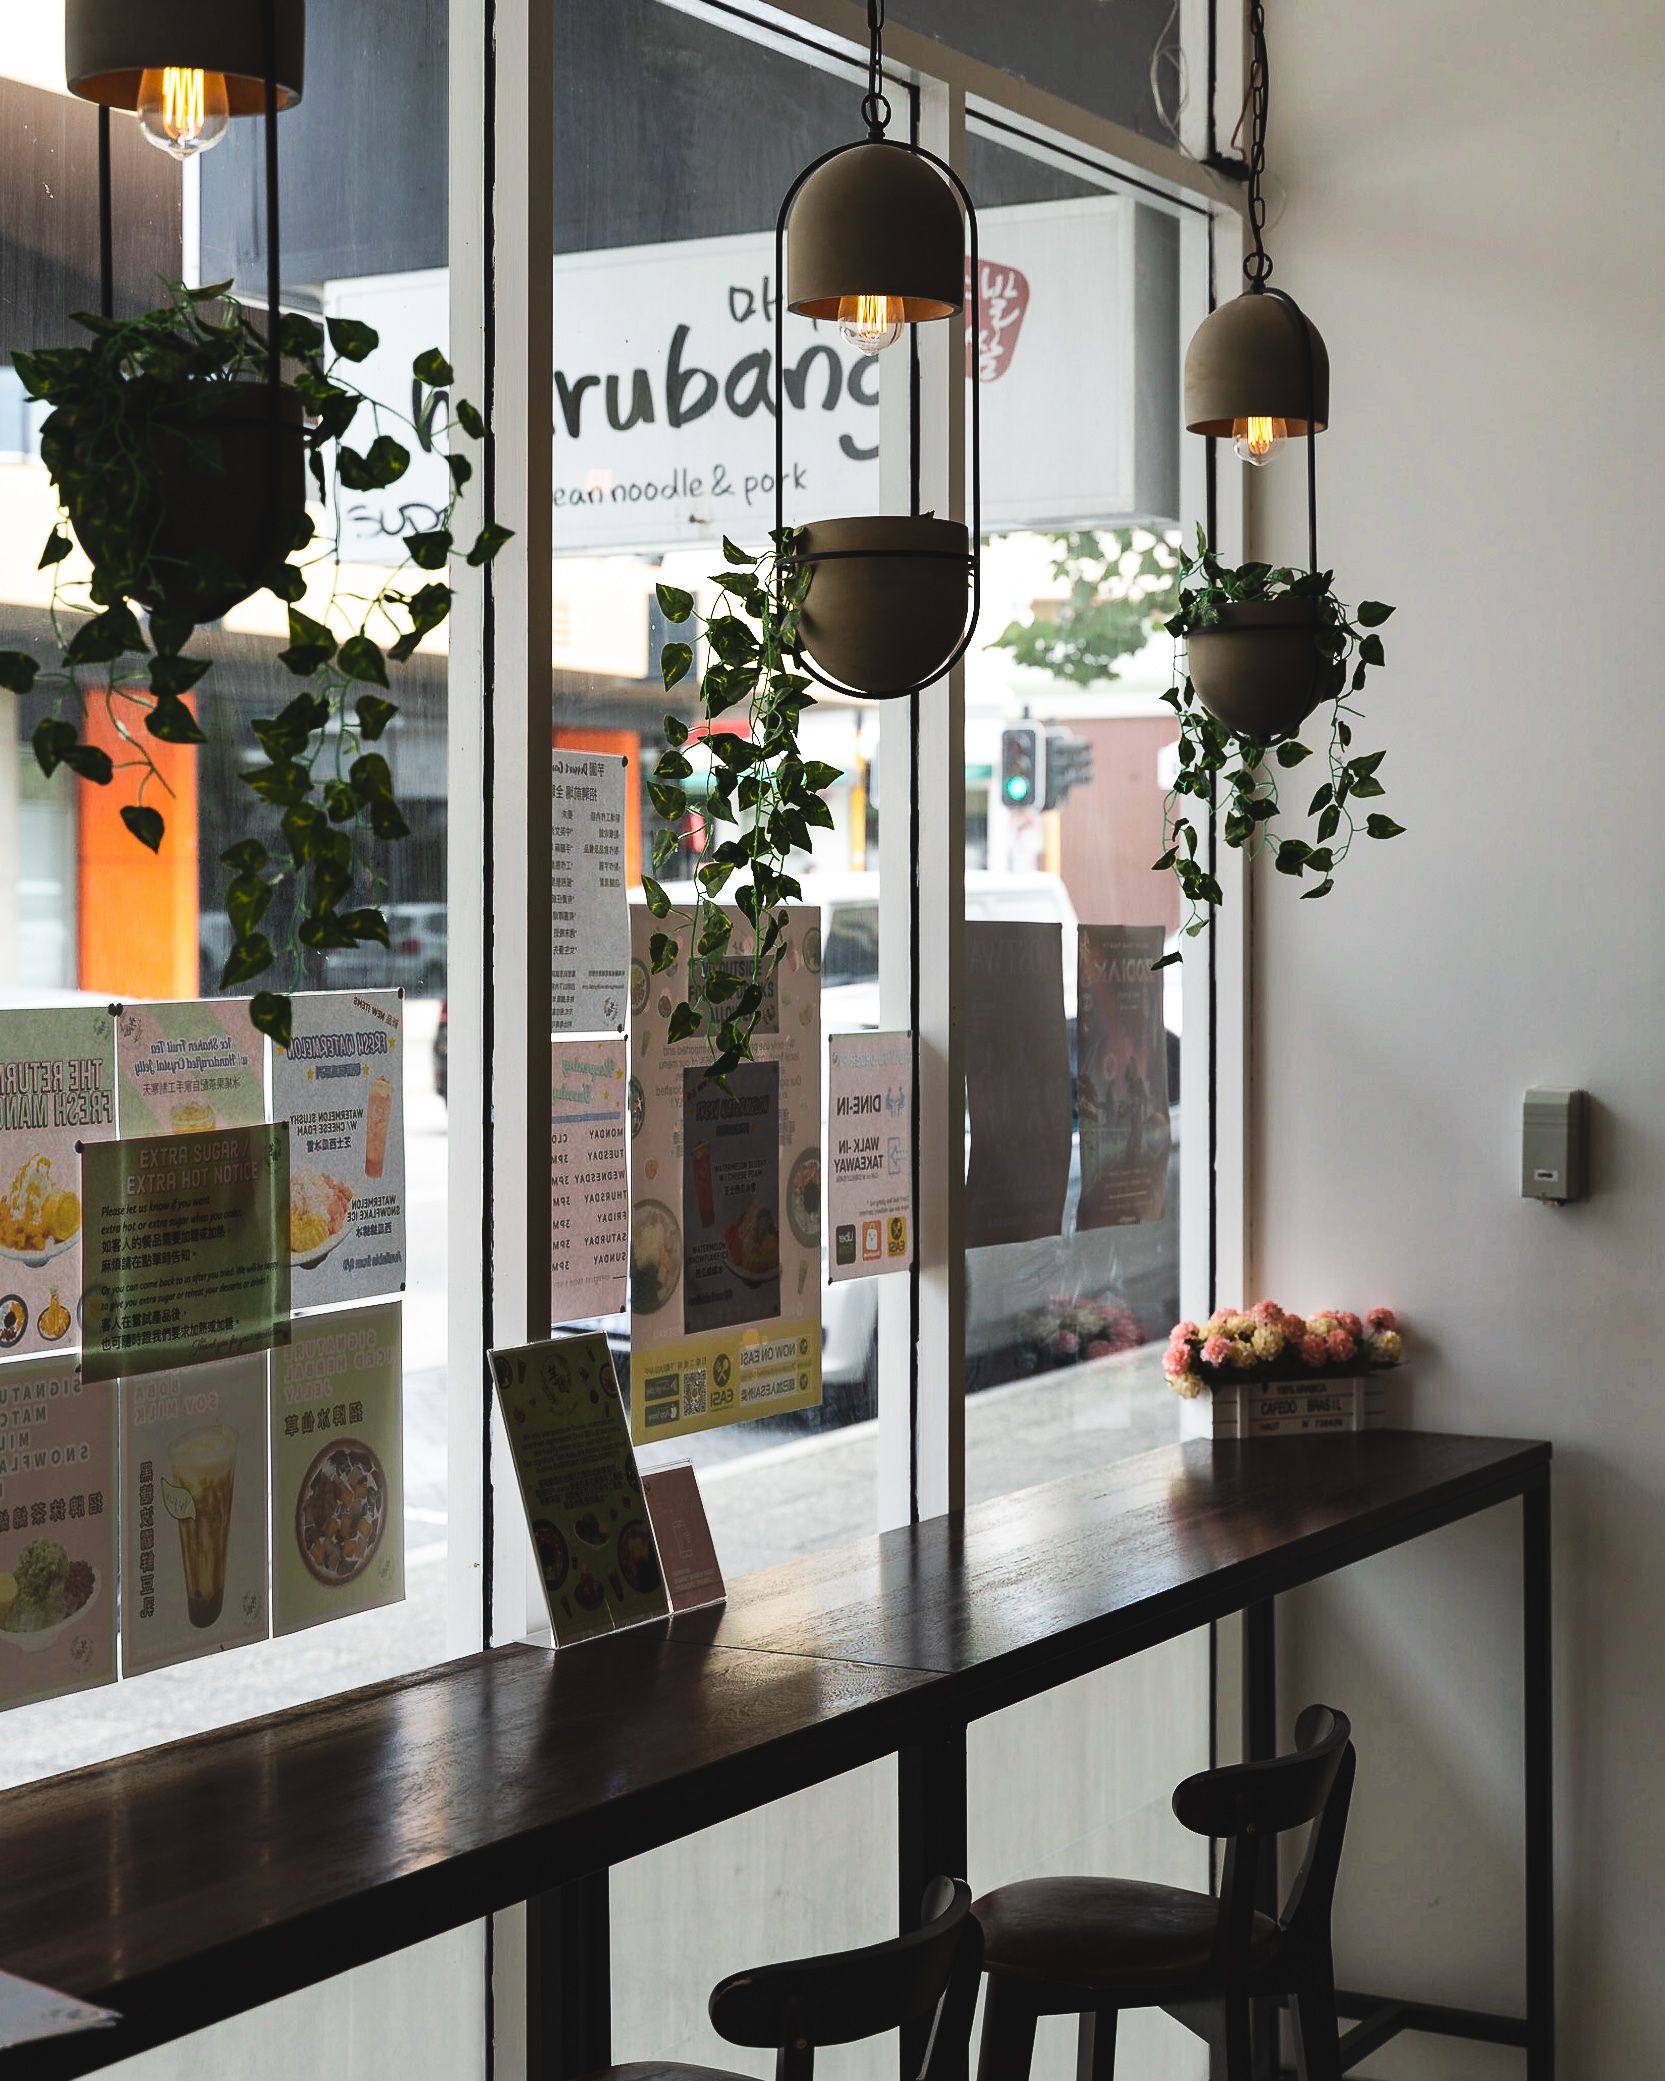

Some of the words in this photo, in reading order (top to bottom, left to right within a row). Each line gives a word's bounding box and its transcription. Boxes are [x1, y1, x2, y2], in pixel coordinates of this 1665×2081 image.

[553, 486, 605, 507] ean
[612, 468, 704, 504] noodle
[711, 463, 735, 497] &
[744, 463, 807, 507] pork
[140, 1144, 188, 1169] EXTRA
[193, 1139, 240, 1163] SUGAR
[127, 1171, 176, 1196] EXTRA
[181, 1168, 208, 1189] HOT
[213, 1160, 259, 1183] NOTICE
[101, 1203, 125, 1217] Please
[126, 1204, 137, 1215] let
[149, 1201, 170, 1212] know
[101, 1224, 121, 1236] extra
[122, 1220, 137, 1233] hot
[111, 1285, 125, 1297] you
[125, 1283, 139, 1292] can
[124, 1299, 138, 1311] you
